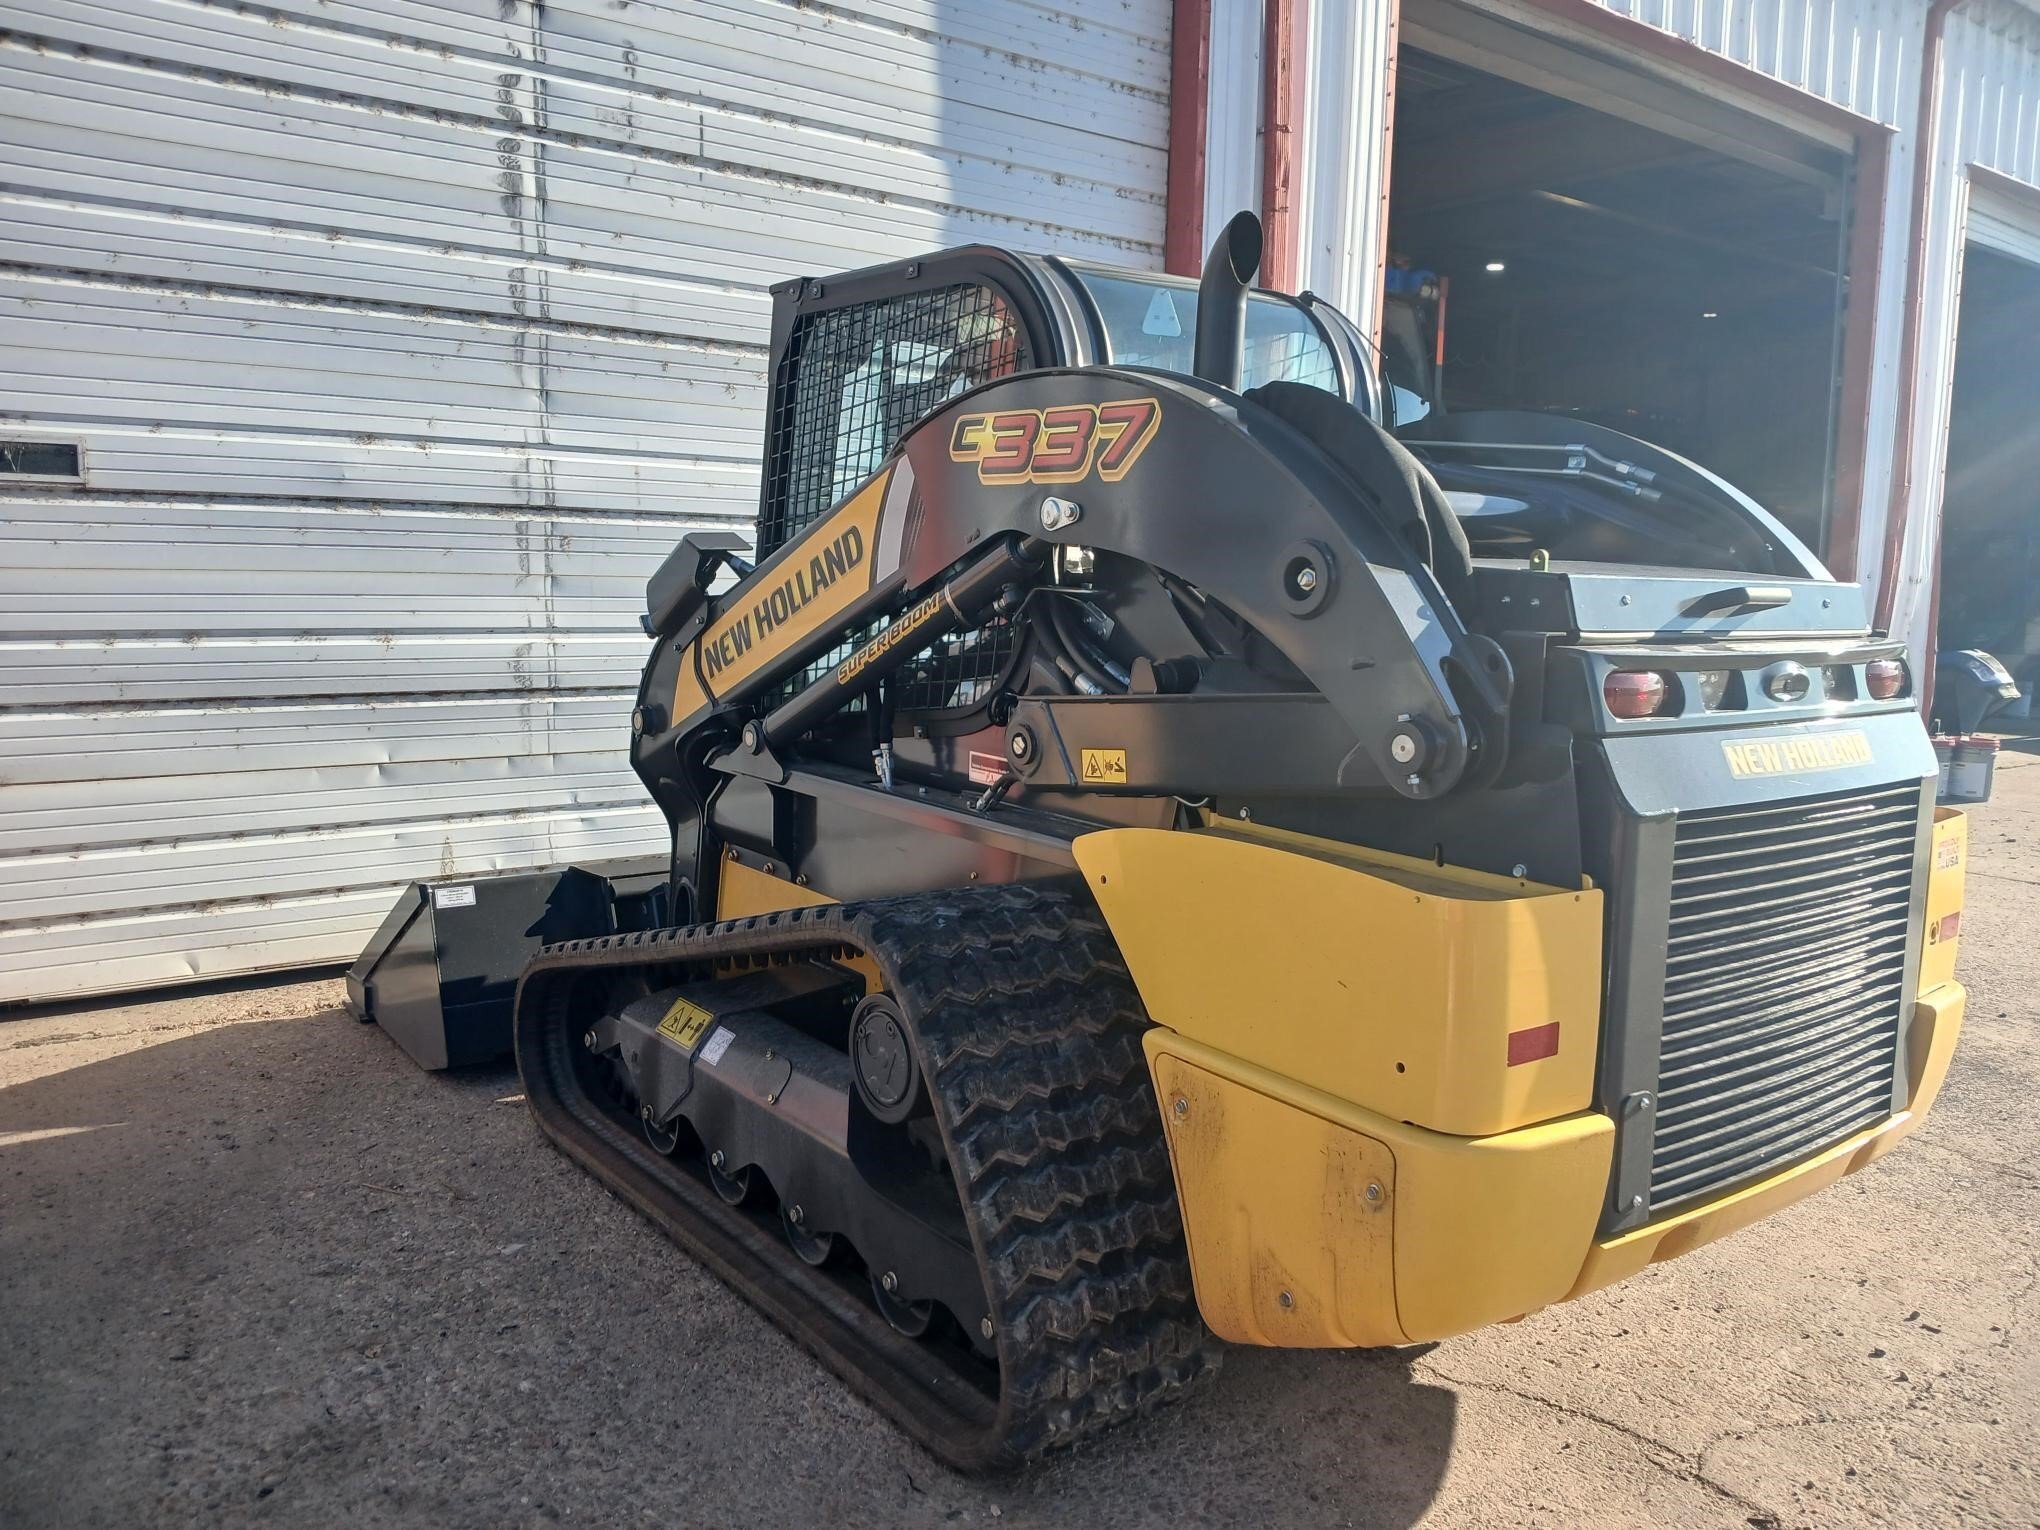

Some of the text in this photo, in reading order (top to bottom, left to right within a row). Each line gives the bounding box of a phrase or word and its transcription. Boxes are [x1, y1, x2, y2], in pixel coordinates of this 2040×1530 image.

[950, 398, 1162, 485] C337
[704, 525, 864, 680] NEW HOLLAND
[1725, 734, 1873, 775] NEW HOLLAND
